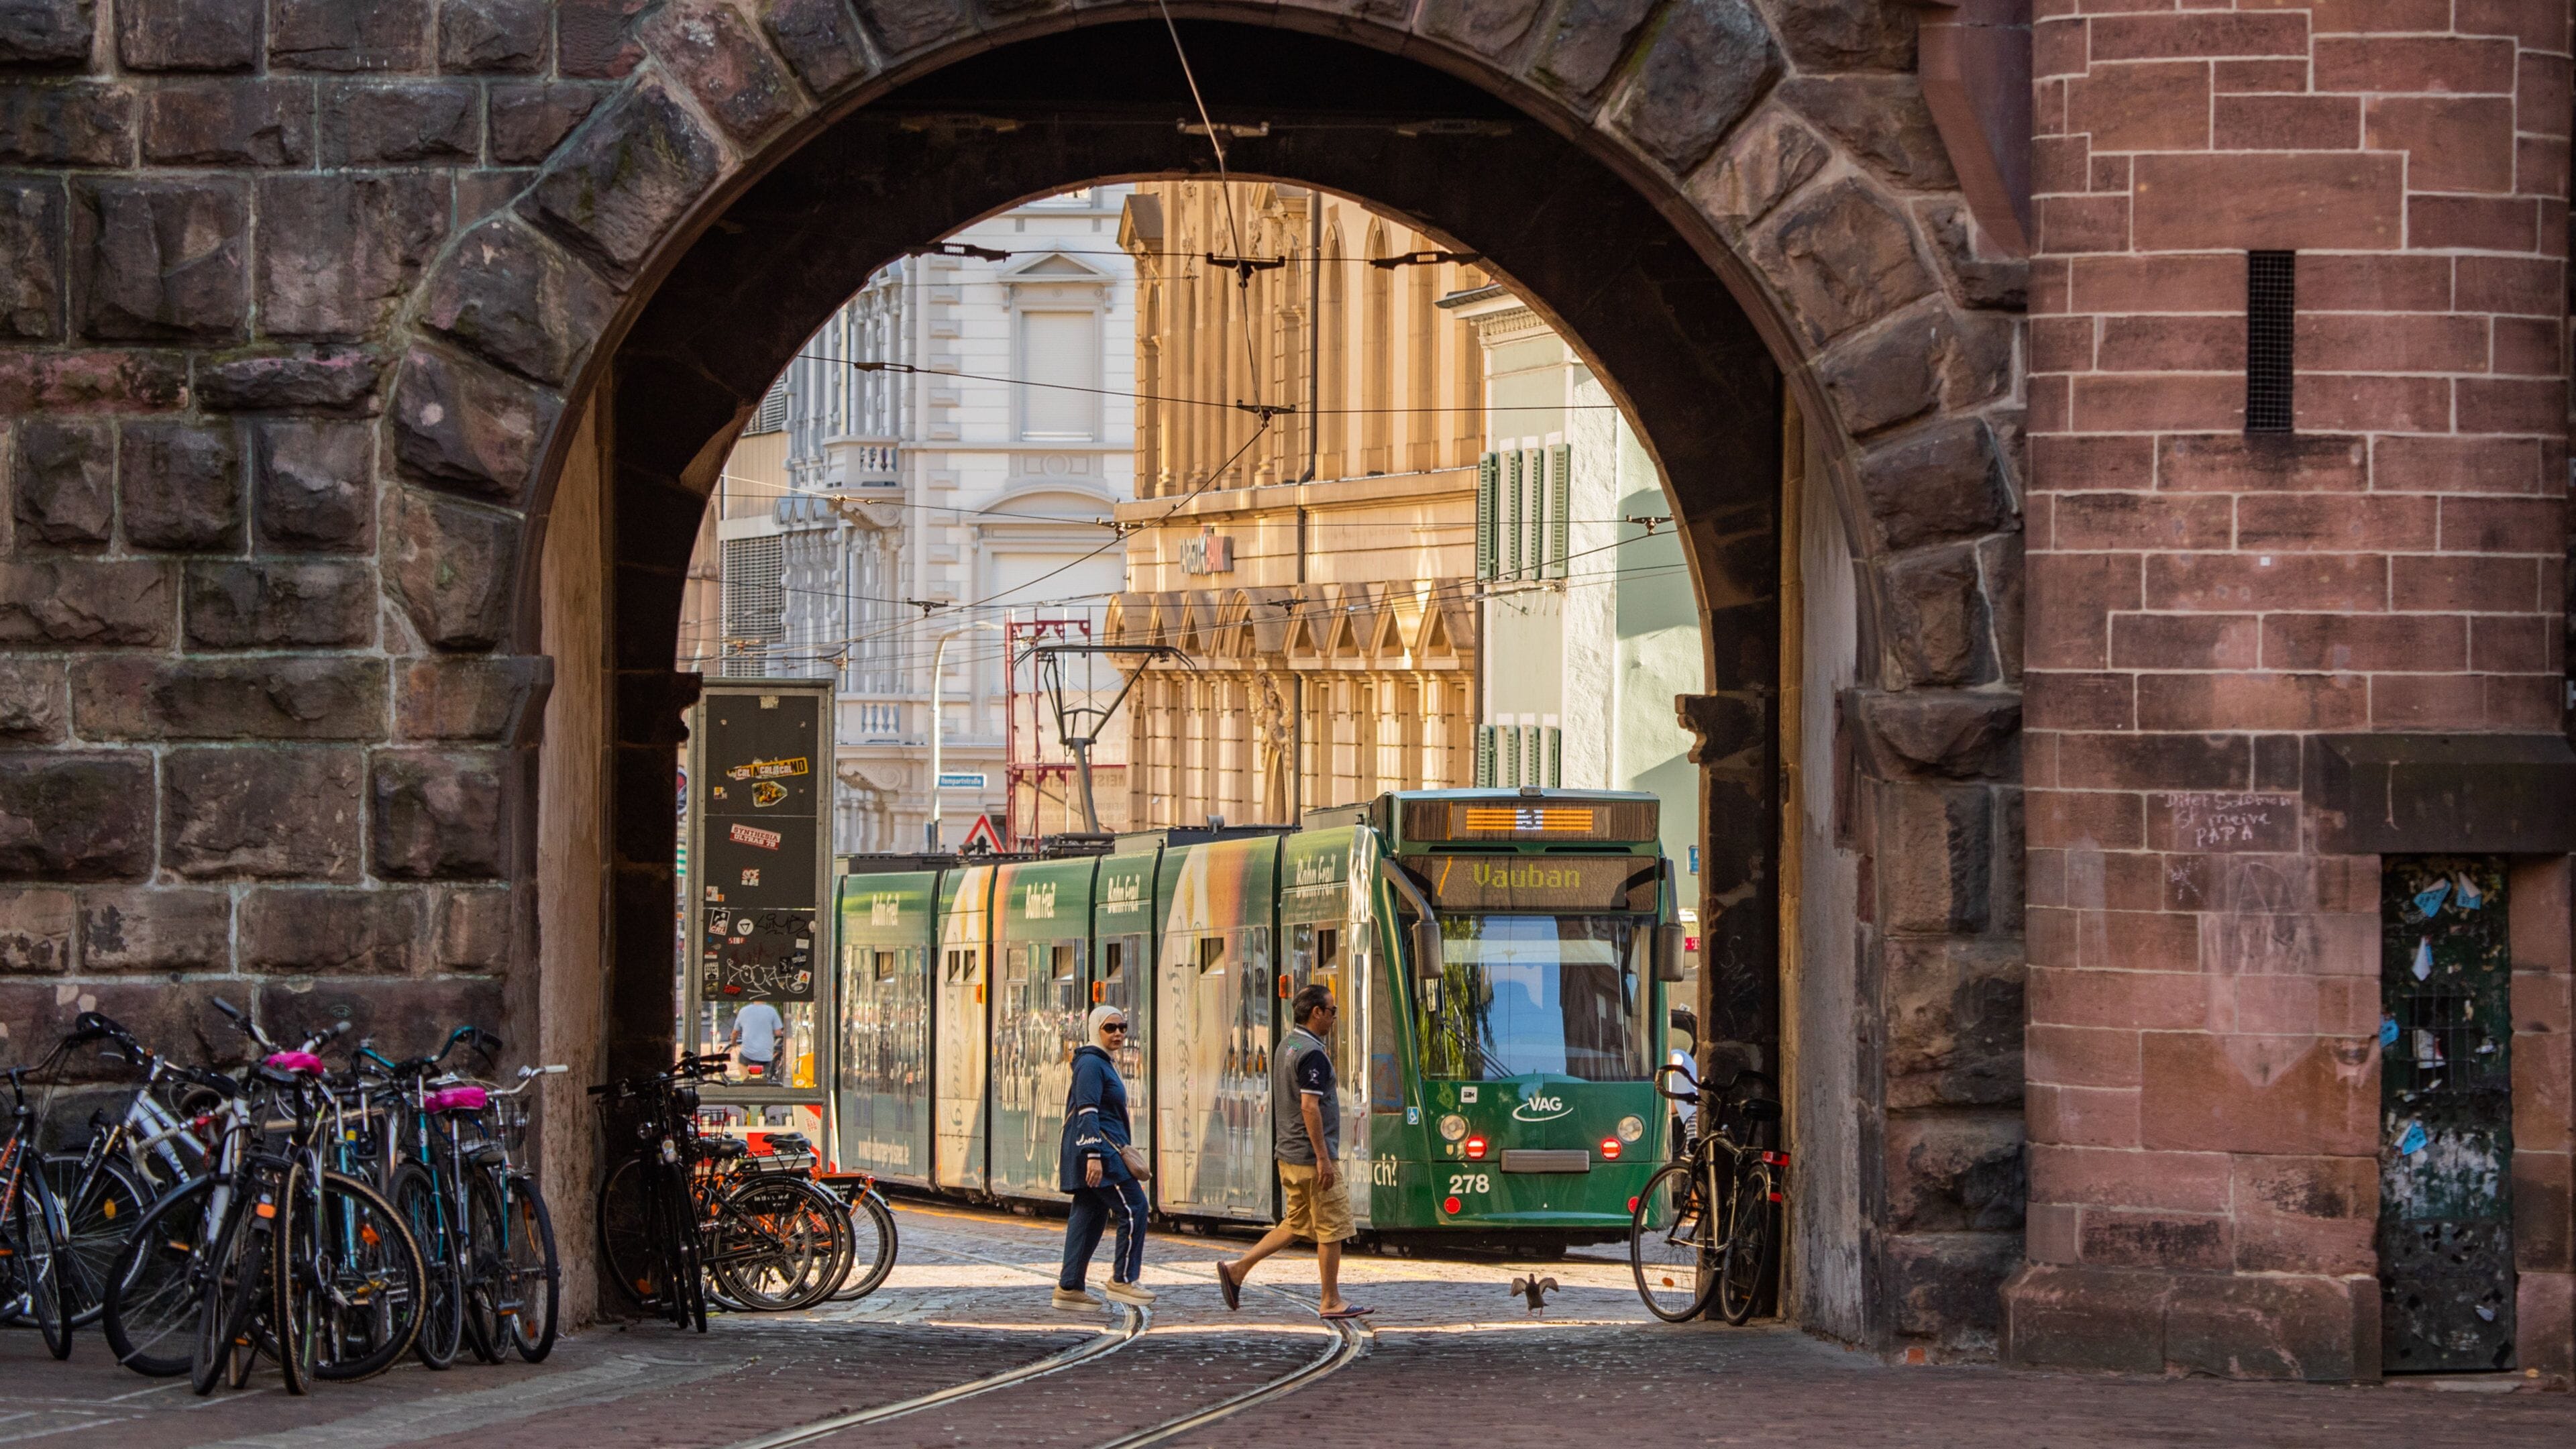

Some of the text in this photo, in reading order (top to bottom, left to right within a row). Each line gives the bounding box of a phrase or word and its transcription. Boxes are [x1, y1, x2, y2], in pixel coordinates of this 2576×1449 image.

[941, 777, 981, 786] Rempartstraße
[734, 826, 778, 841] SYNTHESIA
[734, 835, 764, 845] ULTRAS
[1474, 863, 1580, 889] Vauban
[1528, 1097, 1562, 1111] VAG
[1449, 1174, 1490, 1194] 278
